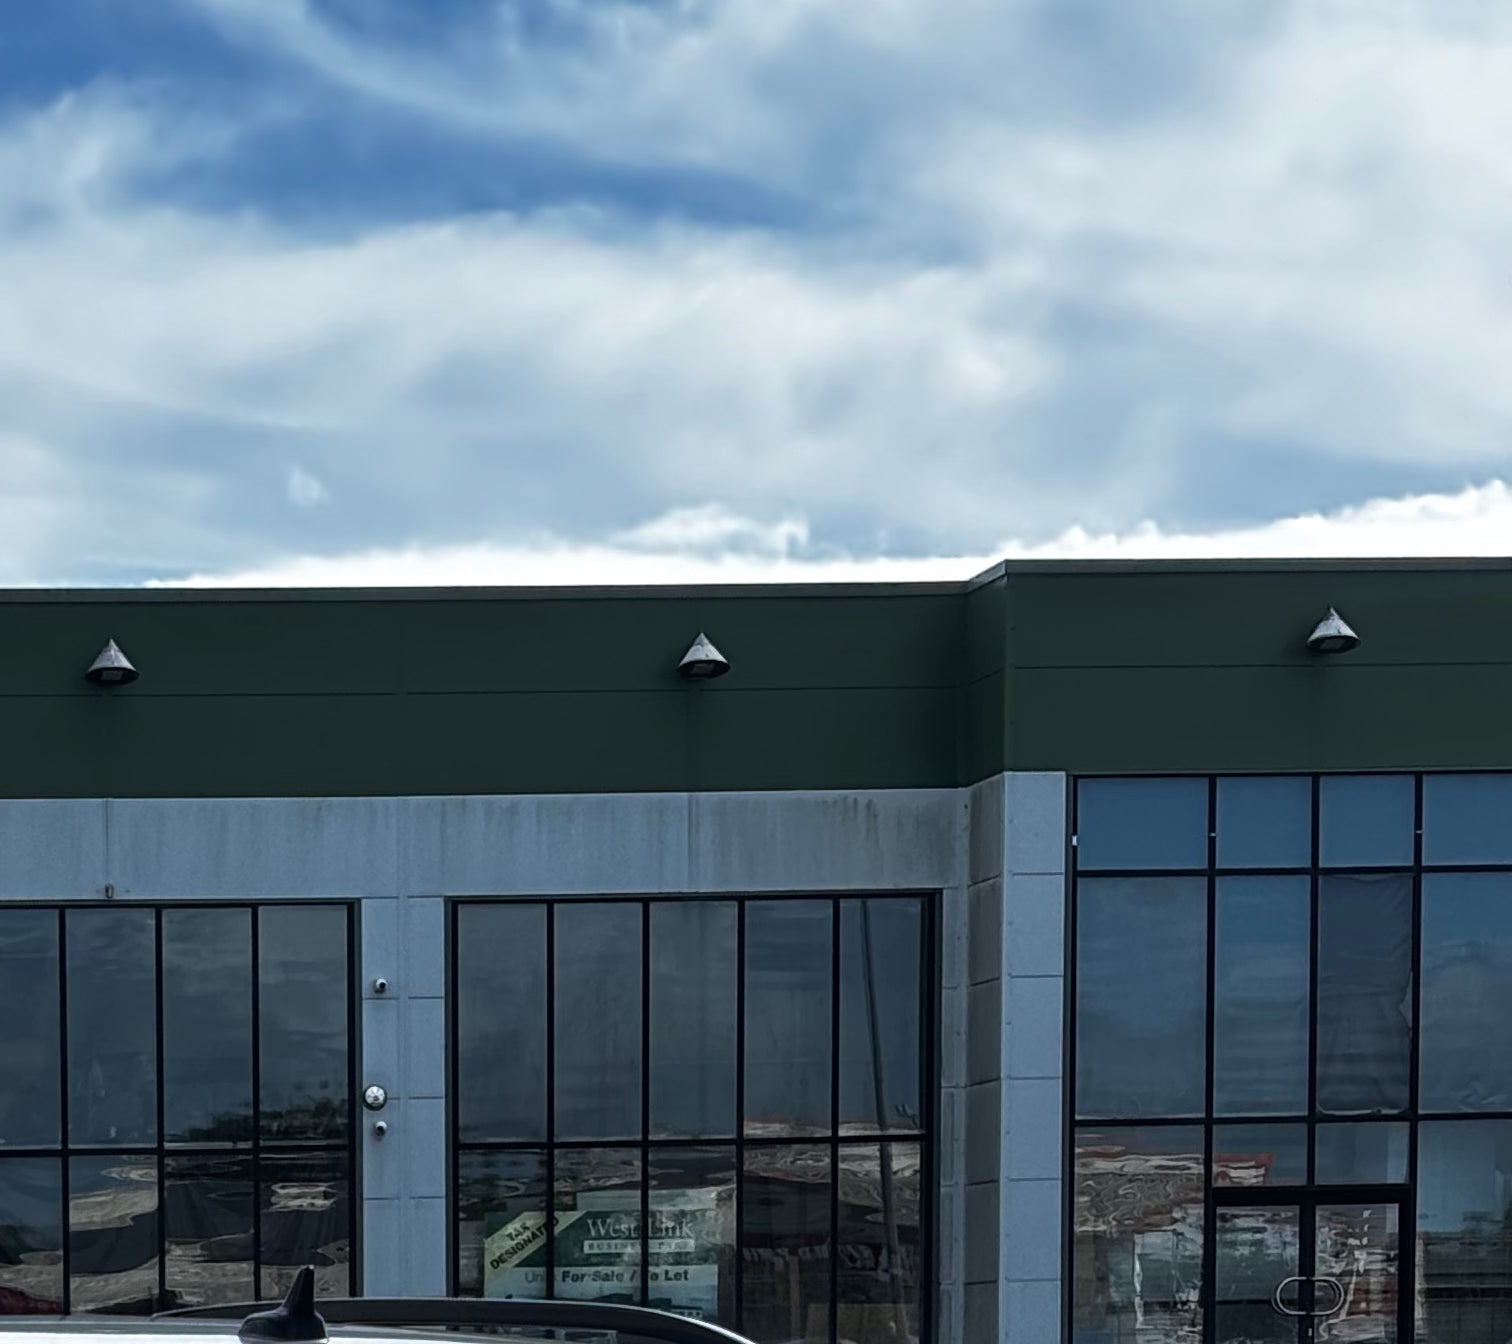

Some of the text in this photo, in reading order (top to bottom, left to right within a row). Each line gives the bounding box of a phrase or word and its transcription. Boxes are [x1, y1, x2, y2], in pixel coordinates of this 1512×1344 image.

[489, 1216, 560, 1270] DESIGNATD
[561, 1270, 586, 1283] For
[591, 1270, 624, 1283] Sale
[664, 1269, 690, 1282] Let
